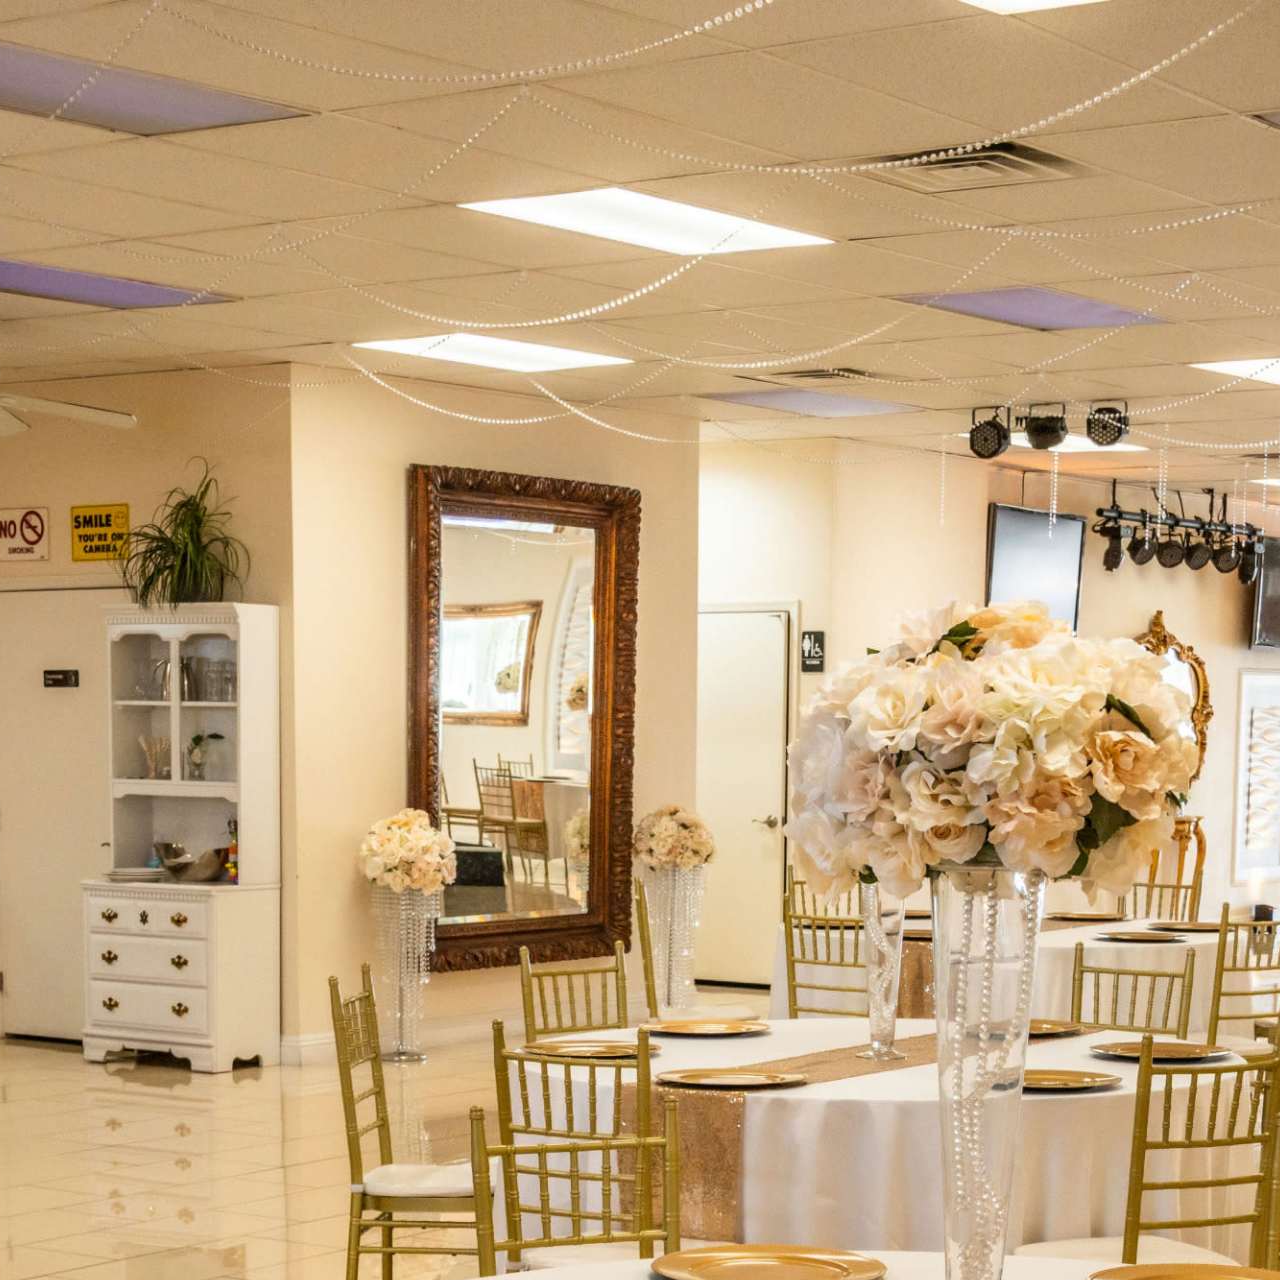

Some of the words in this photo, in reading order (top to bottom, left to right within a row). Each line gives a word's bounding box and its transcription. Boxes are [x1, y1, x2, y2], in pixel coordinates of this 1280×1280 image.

[74, 514, 112, 529] SMILE
[0, 519, 17, 539] NO
[78, 533, 108, 543] YOU'RE
[83, 544, 118, 553] CAMERA
